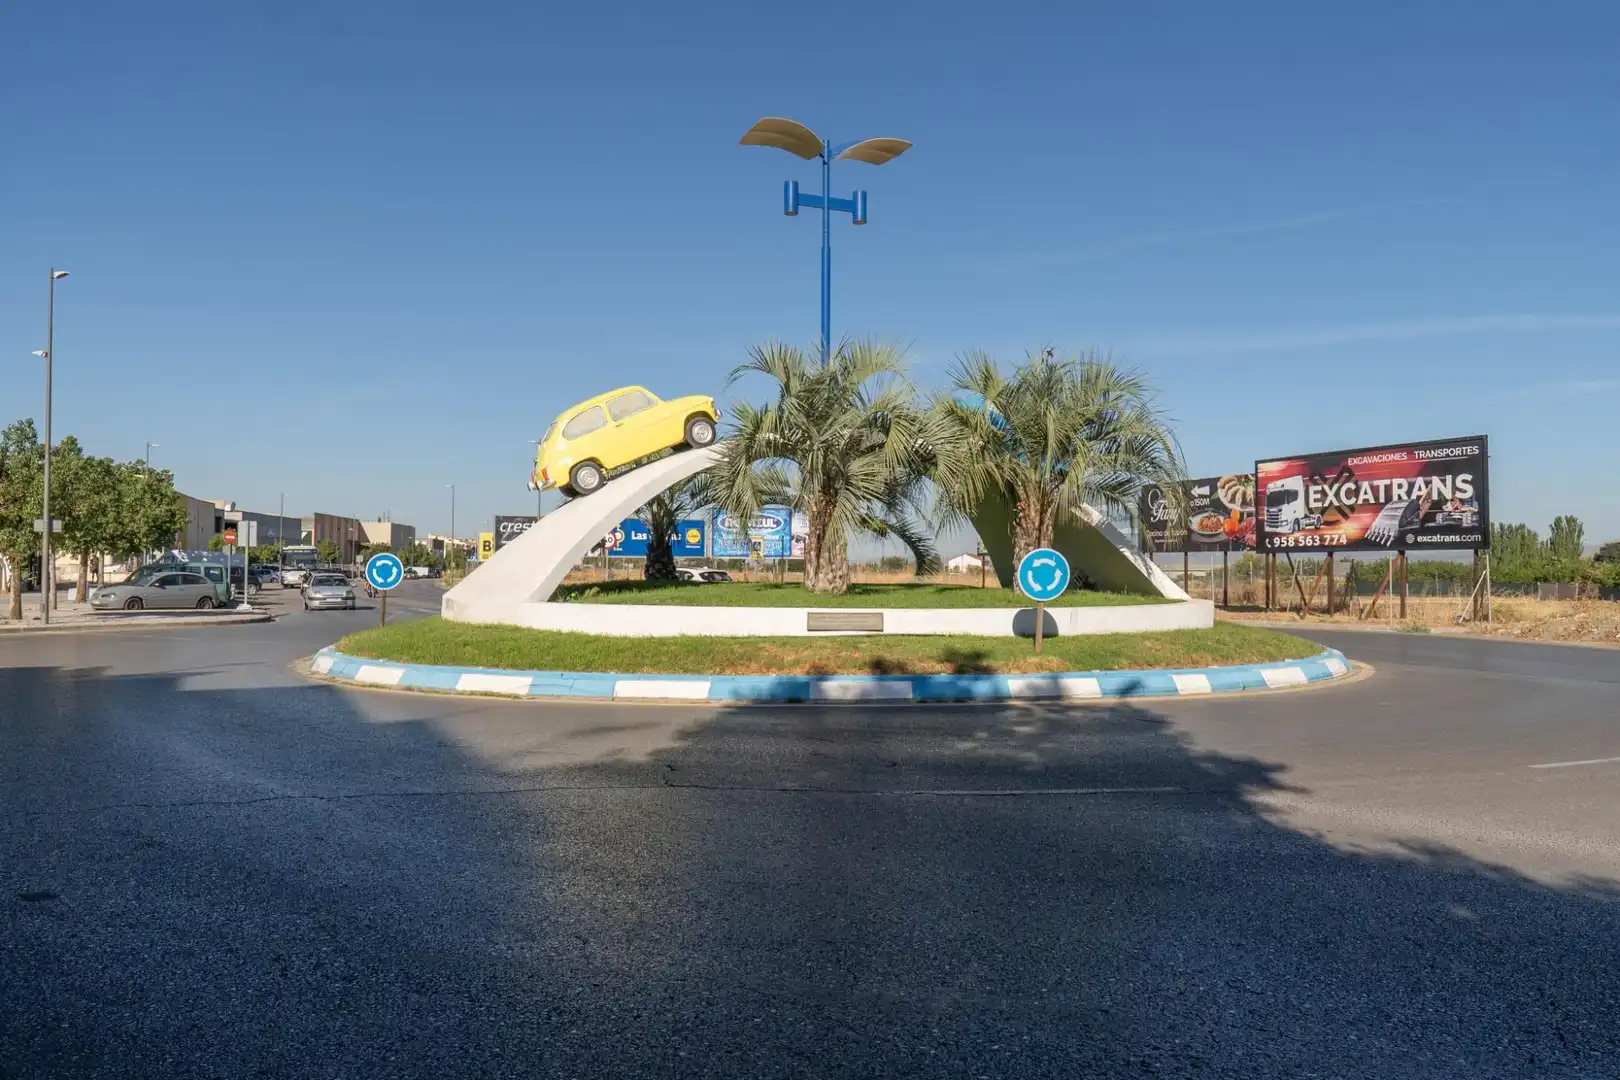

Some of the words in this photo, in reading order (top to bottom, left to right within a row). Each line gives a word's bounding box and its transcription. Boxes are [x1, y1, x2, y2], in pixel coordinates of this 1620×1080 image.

[1348, 452, 1408, 466] EXCAVACIONES
[1414, 445, 1479, 460] TRANSPORTES
[1308, 473, 1474, 508] EXCATRANS
[631, 530, 648, 541] Las
[1273, 537, 1295, 548] 958
[1298, 535, 1320, 547] 563
[1324, 533, 1348, 546] 774
[1416, 533, 1482, 543] excatrans.com
[483, 540, 492, 552] B
